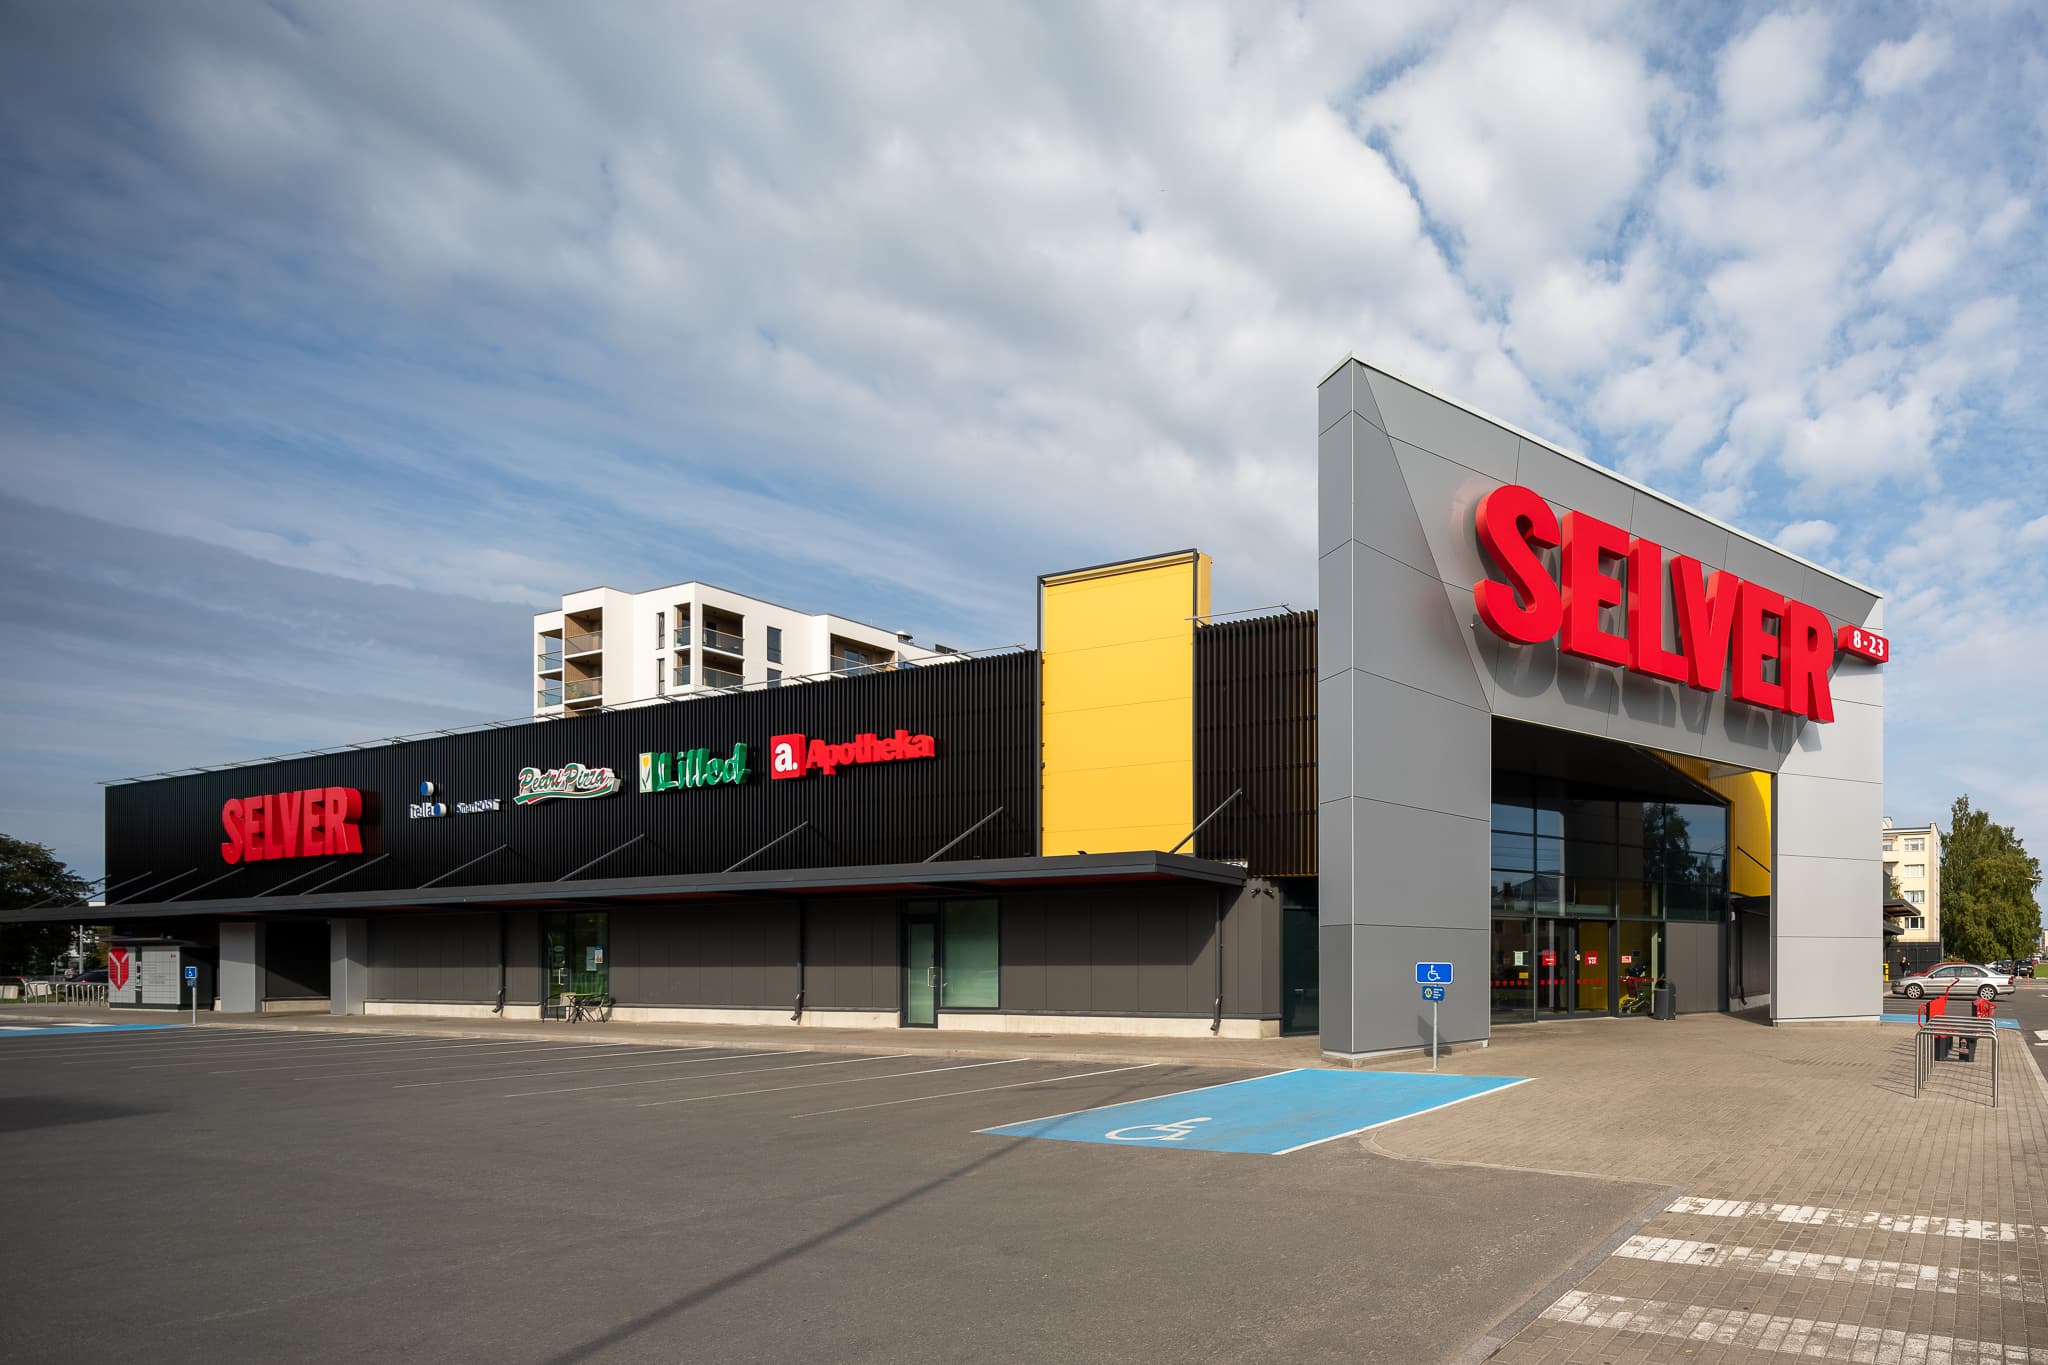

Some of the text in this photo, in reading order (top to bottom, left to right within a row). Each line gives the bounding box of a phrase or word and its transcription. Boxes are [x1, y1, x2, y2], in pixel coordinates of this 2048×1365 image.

[1473, 485, 1834, 723] SELVER
[519, 762, 605, 790] Peetri Pizza
[656, 743, 747, 791] Lilled
[806, 730, 934, 774] Apotheka
[220, 787, 363, 864] SELVER
